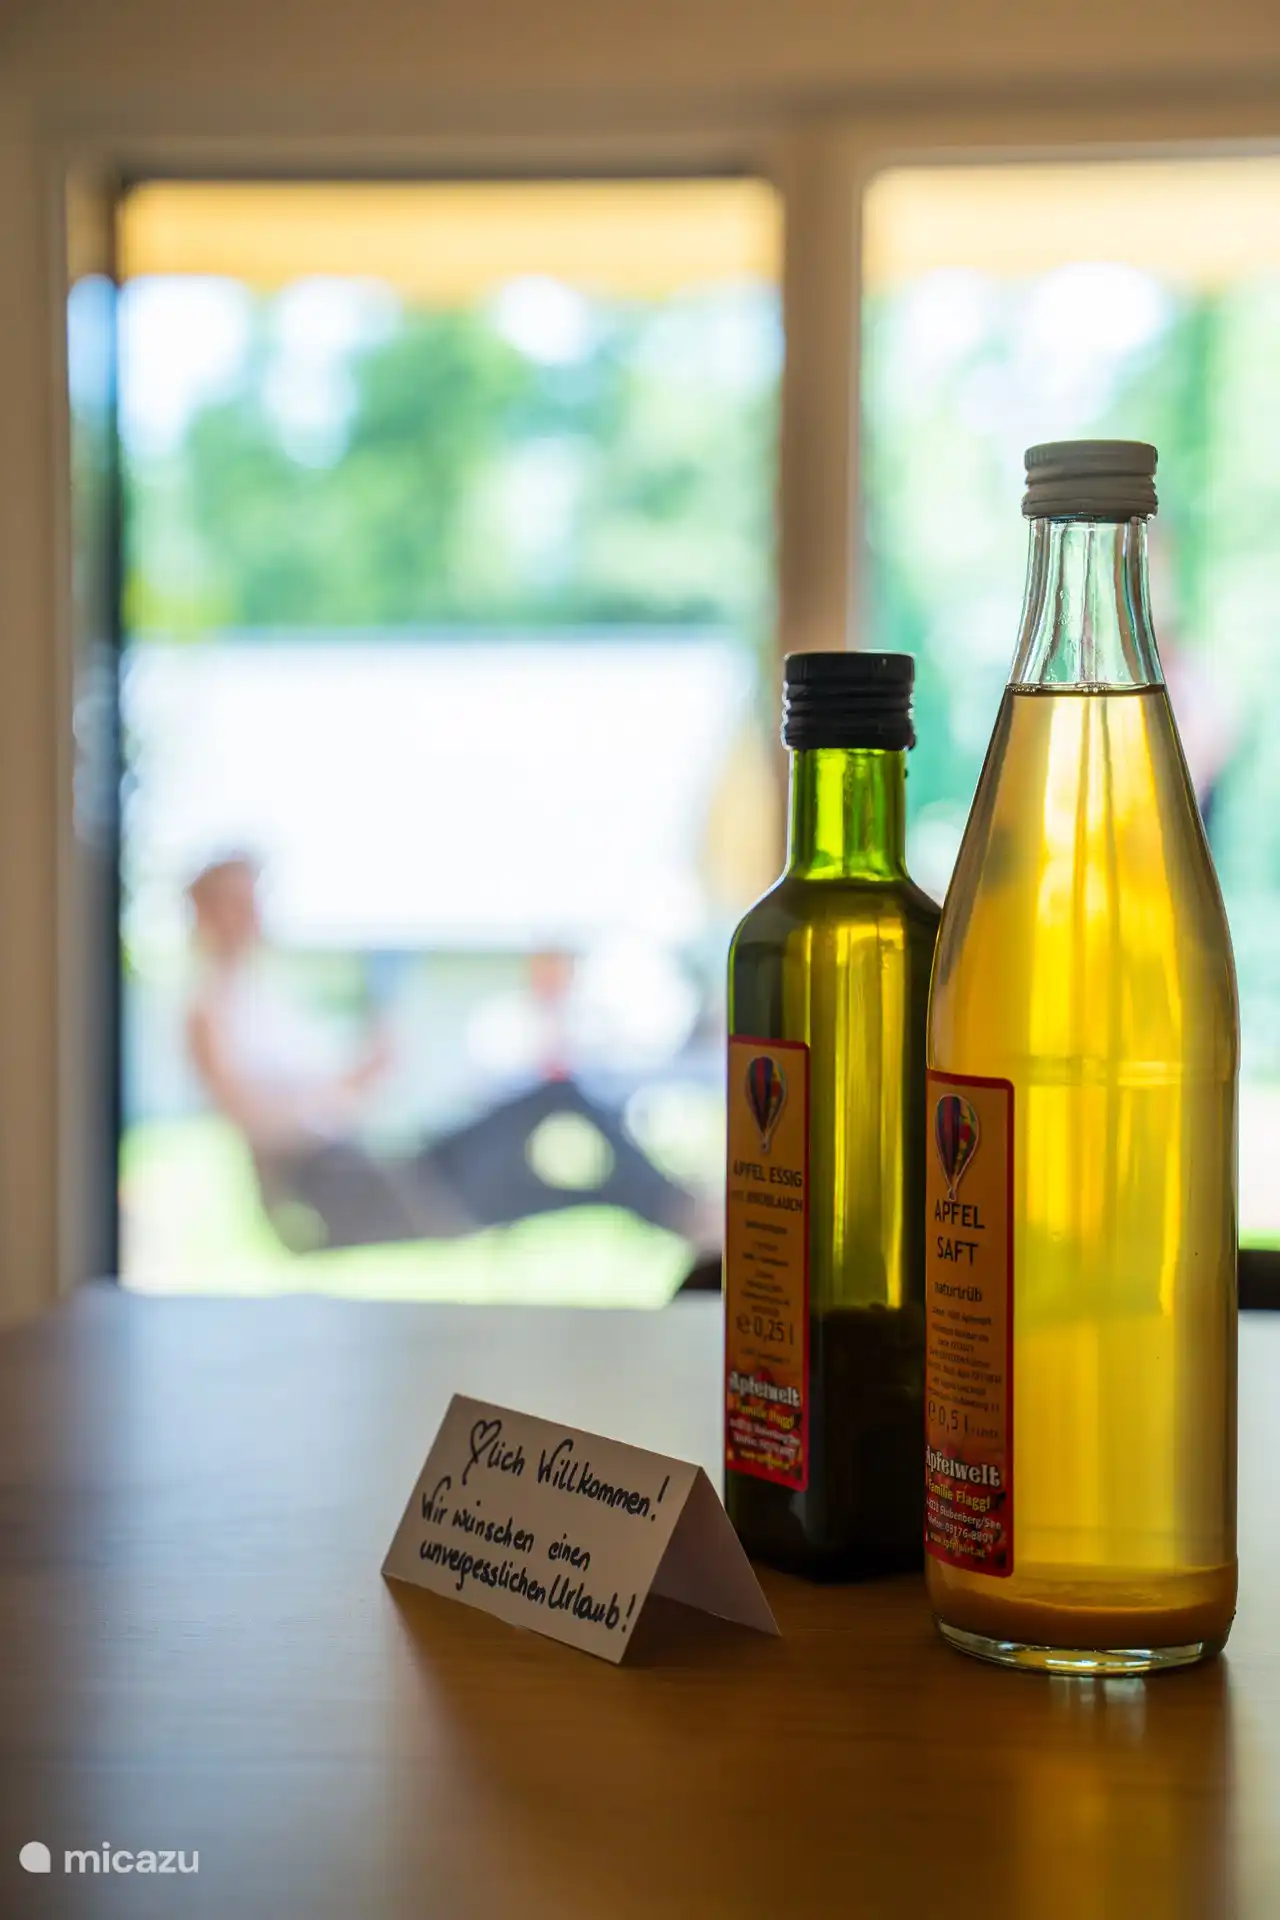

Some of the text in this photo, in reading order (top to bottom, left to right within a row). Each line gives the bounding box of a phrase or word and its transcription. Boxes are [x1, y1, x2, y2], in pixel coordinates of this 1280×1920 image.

[934, 1199, 986, 1230] APFEL
[936, 1235, 979, 1267] SAFT
[932, 1281, 983, 1303] naturtrüb
[537, 1438, 670, 1521] Willkommen!
[421, 1476, 592, 1572] Wir wünschen einen
